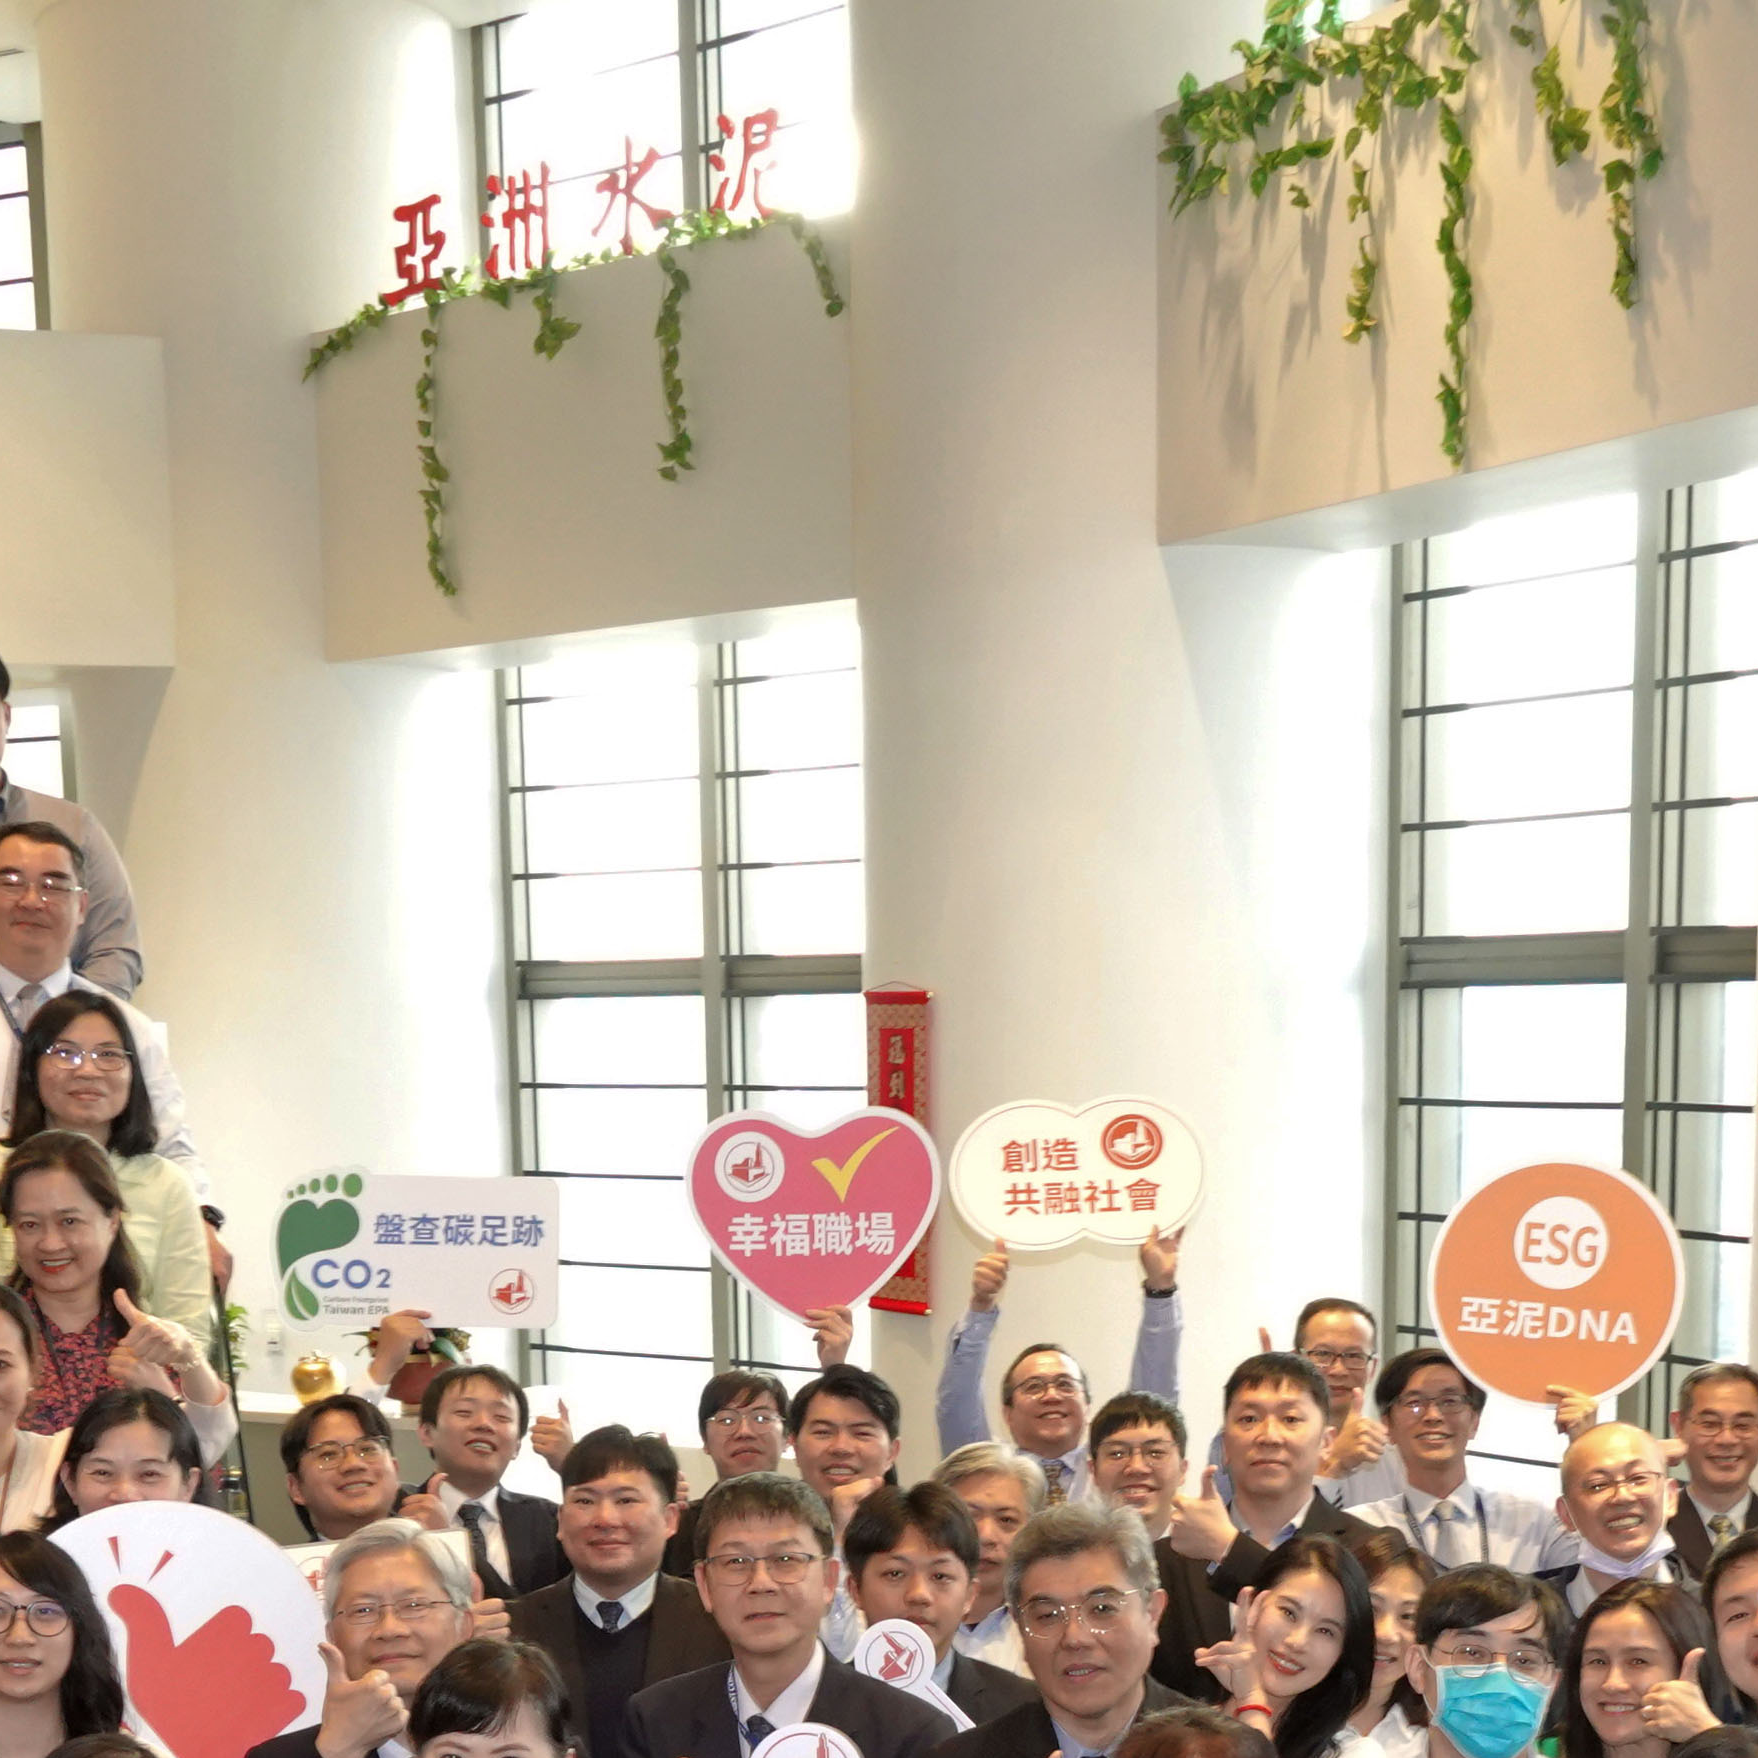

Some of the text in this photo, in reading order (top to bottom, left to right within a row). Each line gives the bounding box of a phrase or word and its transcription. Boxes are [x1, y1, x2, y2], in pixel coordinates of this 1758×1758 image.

[381, 107, 780, 306] 亞洲水泥
[1001, 1138, 1078, 1173] 創造
[1005, 1178, 1161, 1217] 共融社會
[373, 1213, 545, 1248] 盤查碳足跡
[728, 1211, 897, 1258] 幸福職場
[1521, 1222, 1599, 1268] ESG
[323, 1305, 365, 1316] Taiwan
[1457, 1296, 1638, 1344] 亞泥DNA
